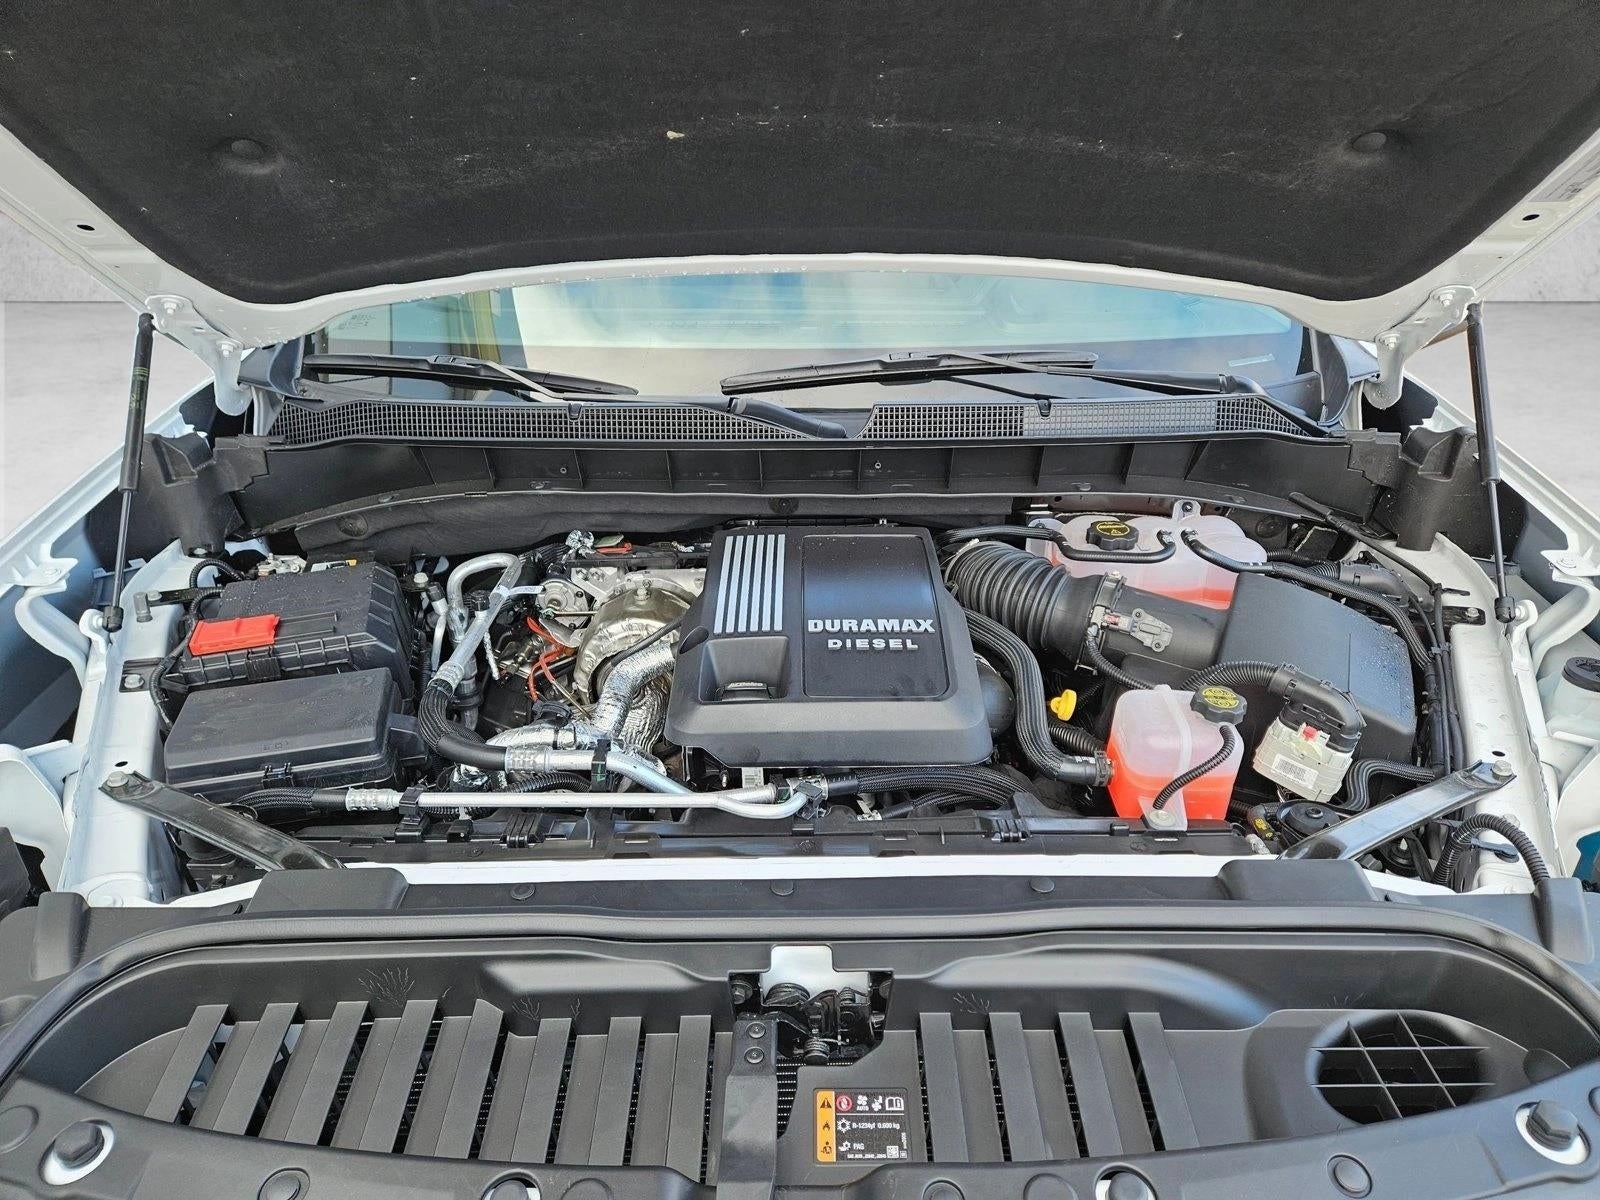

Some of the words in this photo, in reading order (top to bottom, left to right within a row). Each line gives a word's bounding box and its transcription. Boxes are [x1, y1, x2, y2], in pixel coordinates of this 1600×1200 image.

[807, 618, 936, 634] DURAMAX
[827, 638, 919, 651] DIESEL
[892, 1122, 900, 1130] kg
[853, 1142, 865, 1151] PAG
